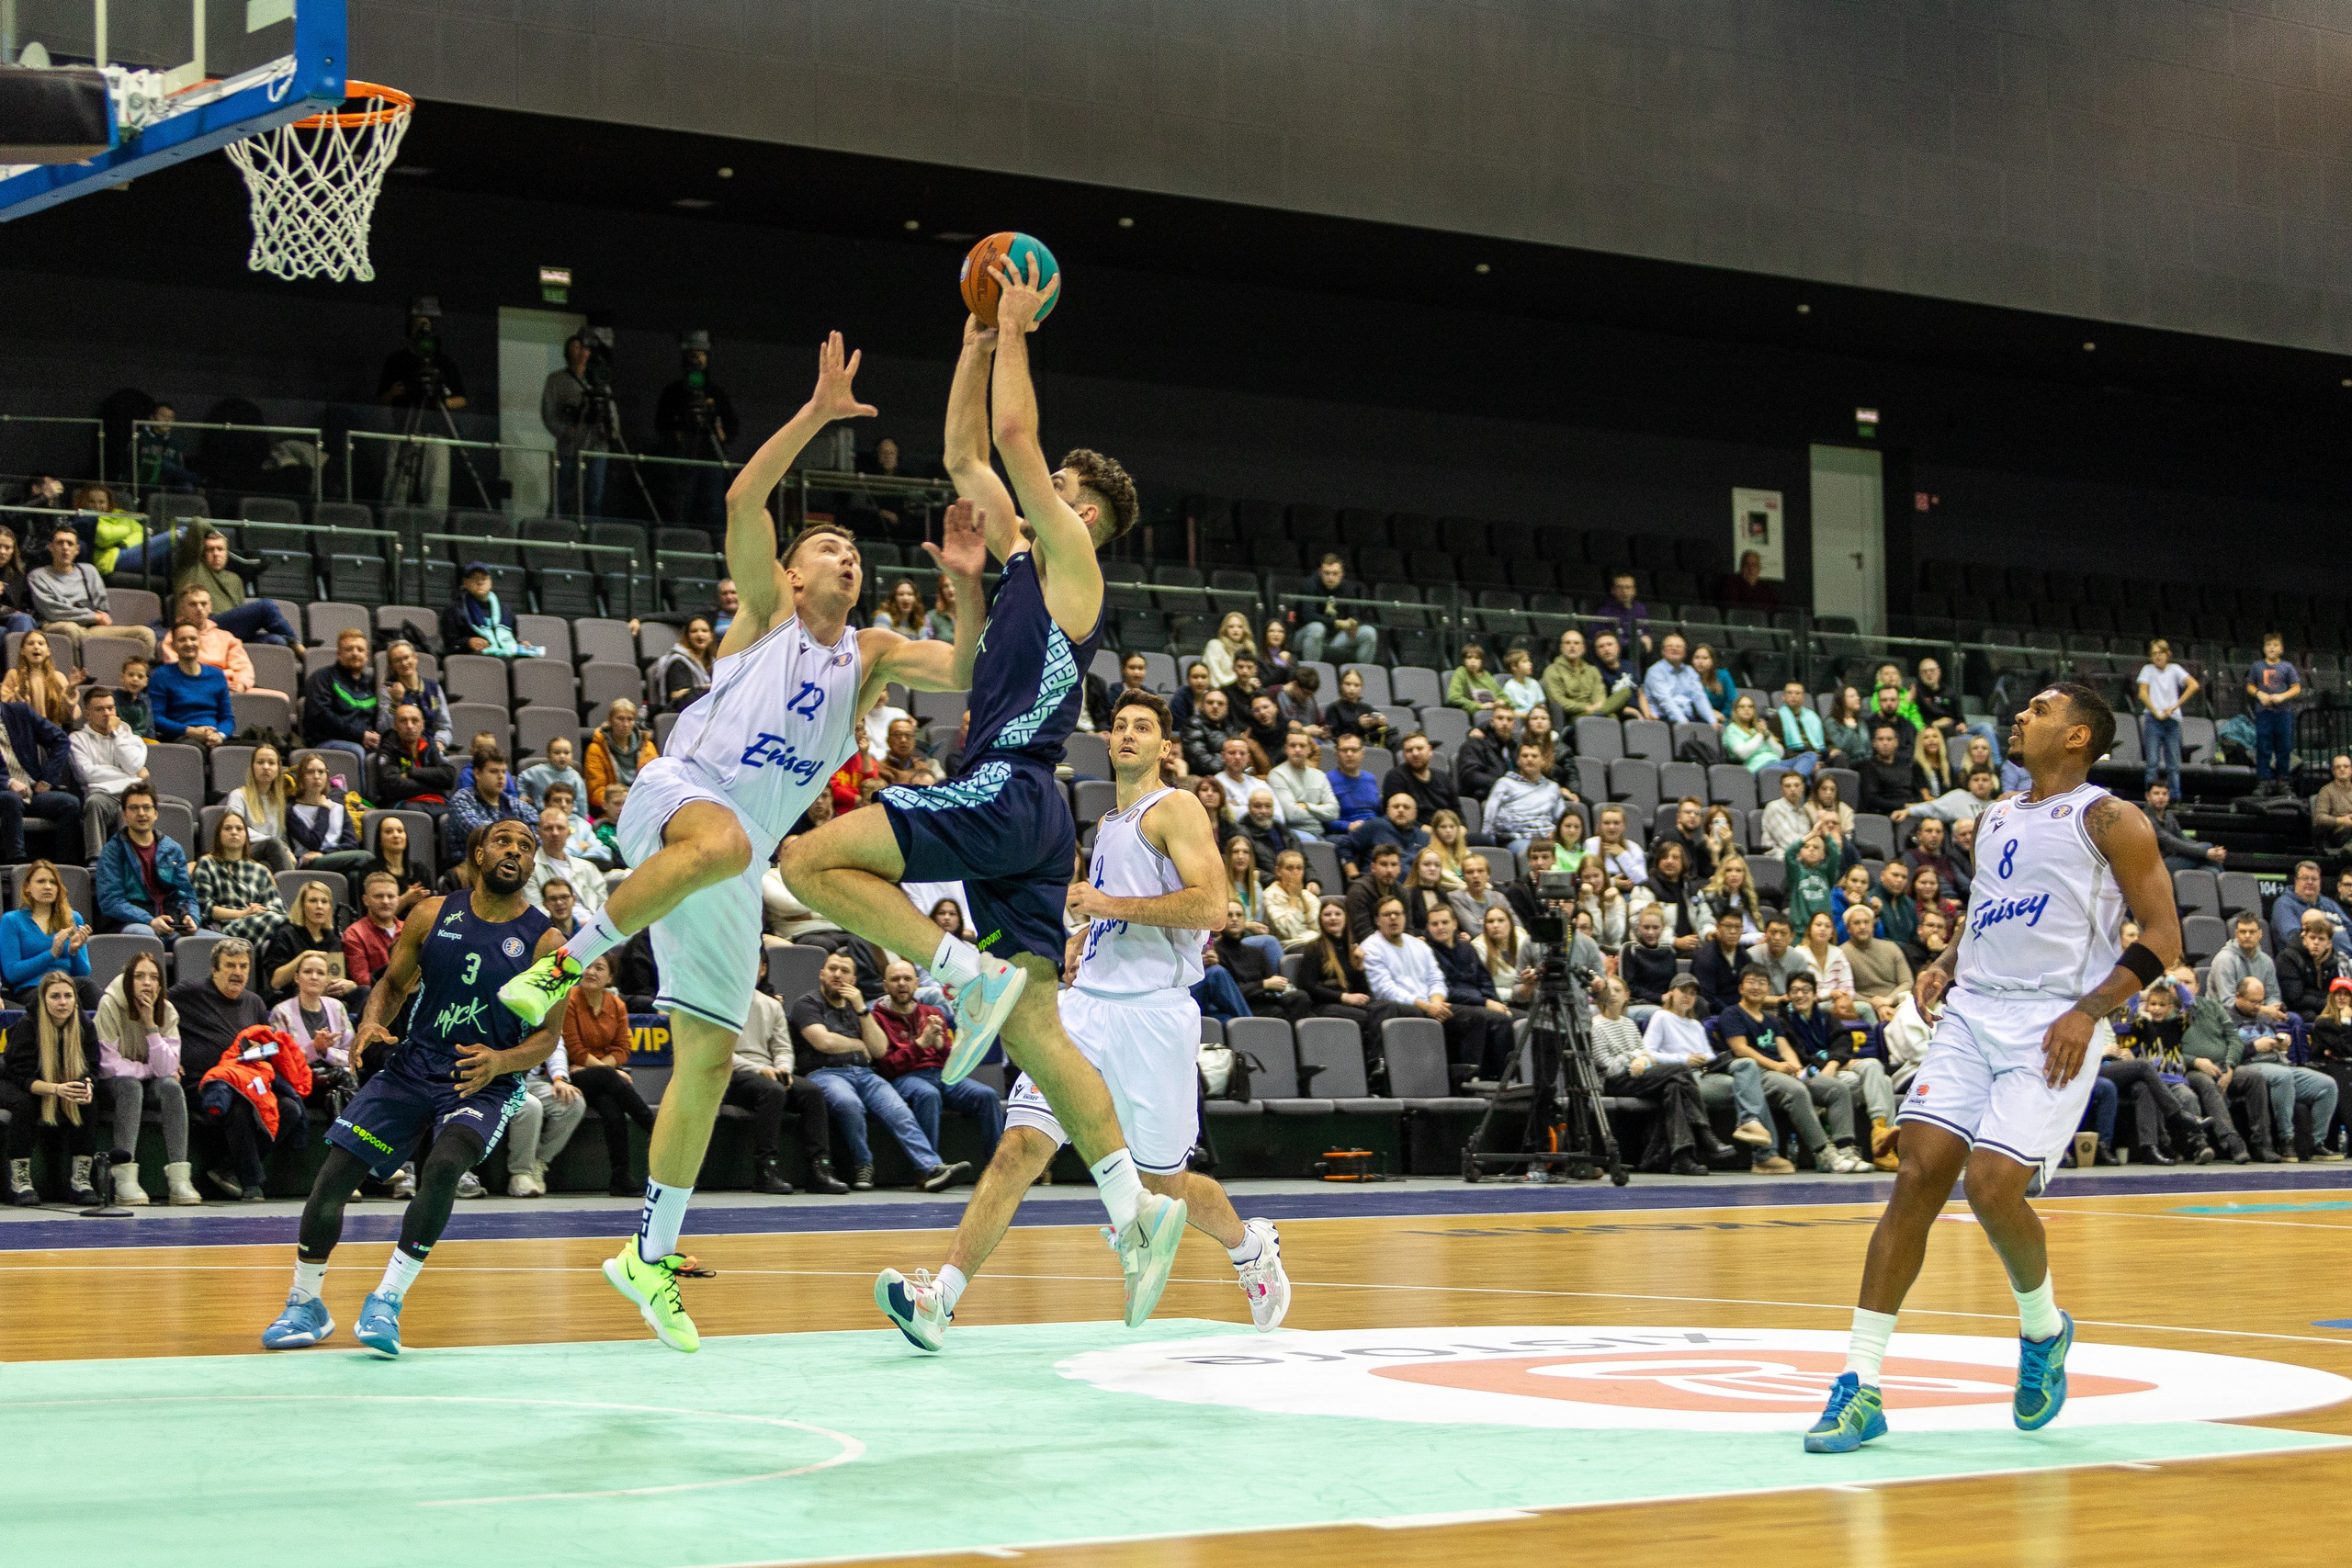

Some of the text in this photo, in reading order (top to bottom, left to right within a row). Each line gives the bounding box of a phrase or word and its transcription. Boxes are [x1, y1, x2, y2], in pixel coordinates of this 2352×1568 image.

[786, 680, 825, 722] 12
[1998, 839, 2018, 879] 8
[437, 929, 462, 941] Kempa
[460, 952, 482, 986] 3
[628, 1027, 670, 1052] VIP
[352, 1124, 394, 1155] евроопт
